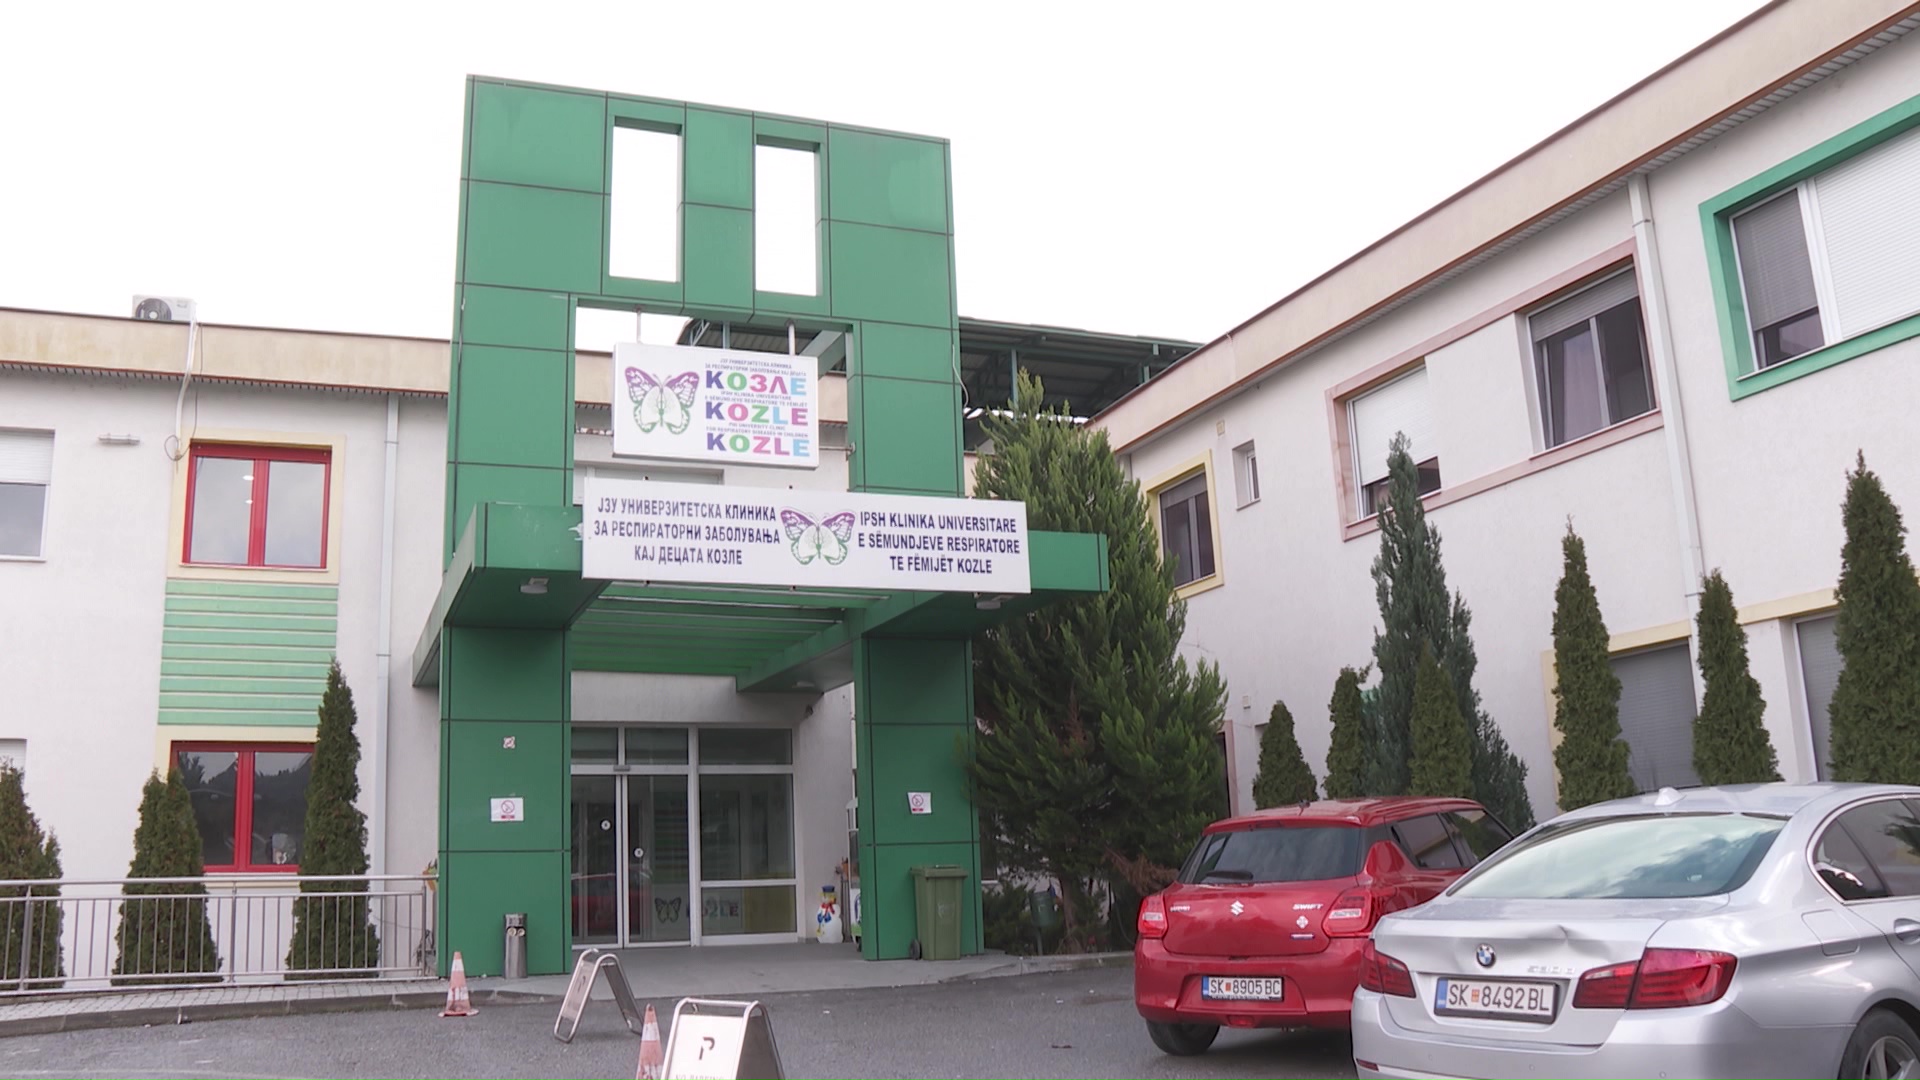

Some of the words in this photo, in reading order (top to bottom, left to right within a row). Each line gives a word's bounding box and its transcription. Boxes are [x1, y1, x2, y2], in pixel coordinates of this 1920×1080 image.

[705, 370, 807, 396] КОЗЛЕ
[705, 401, 809, 427] KOZLE
[707, 432, 810, 457] KOZLE
[597, 496, 619, 513] ЈЗУ
[620, 497, 722, 519] УНИВЕРЗИТЕТСКА
[725, 503, 777, 522] КЛИНИКА
[593, 519, 608, 537] ЗА
[611, 520, 702, 541] РЕСПИРАТОРНИ
[705, 525, 781, 544] ЗАБОЛУВАЊА
[860, 510, 886, 527] IPSH
[889, 511, 935, 530] KLINIKA
[938, 514, 1017, 533] UNIVERSITARE
[858, 532, 865, 547] E
[868, 530, 944, 551] SËMUNDJEVE
[946, 536, 1021, 554] RESPIRATORE
[634, 545, 656, 562] КАЈ
[658, 547, 703, 566] ДЕЦАТА
[706, 548, 742, 565] КОЗЛЕ
[890, 555, 905, 571] TE
[907, 553, 954, 573] FËMIJËT
[957, 557, 993, 575] KOZLE
[1210, 979, 1224, 994] SK
[1448, 984, 1469, 1006] SK
